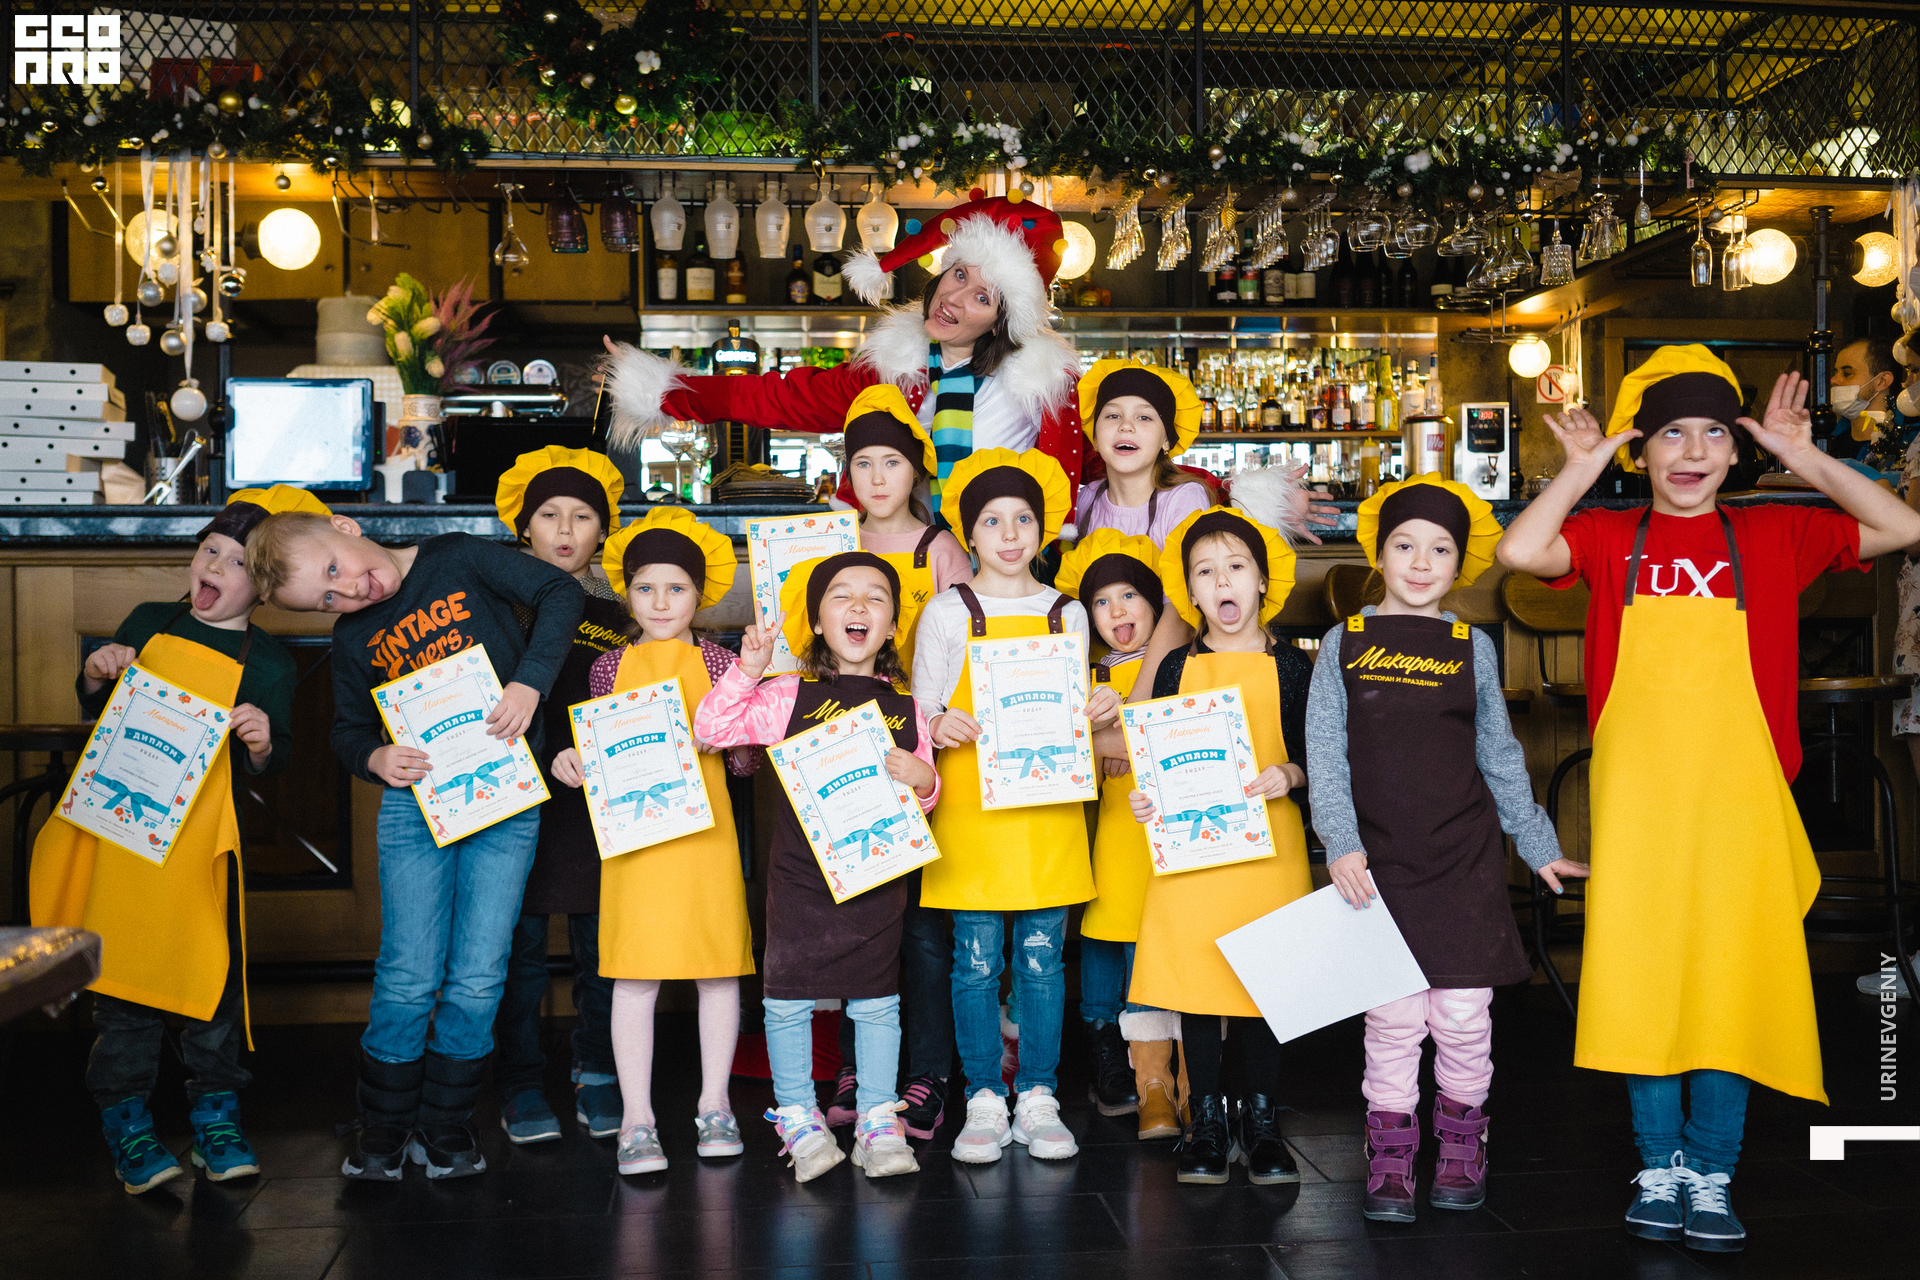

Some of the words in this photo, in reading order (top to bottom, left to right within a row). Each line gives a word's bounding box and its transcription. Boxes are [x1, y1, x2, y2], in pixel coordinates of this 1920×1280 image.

[367, 591, 471, 672] VINTAGE
[1346, 645, 1464, 675] Макароны
[1362, 674, 1395, 683] РЕСТОРАН
[1402, 677, 1439, 687] ПРАЗДНИК
[1009, 693, 1056, 706] ДИПЛОМ
[428, 711, 476, 737] ДИПЛОМ
[132, 731, 178, 758] ДИПЛОМ
[614, 734, 660, 754] ДИПЛОМ
[1169, 751, 1219, 767] ДИПЛОМ
[826, 768, 871, 795] ДИПЛОМ
